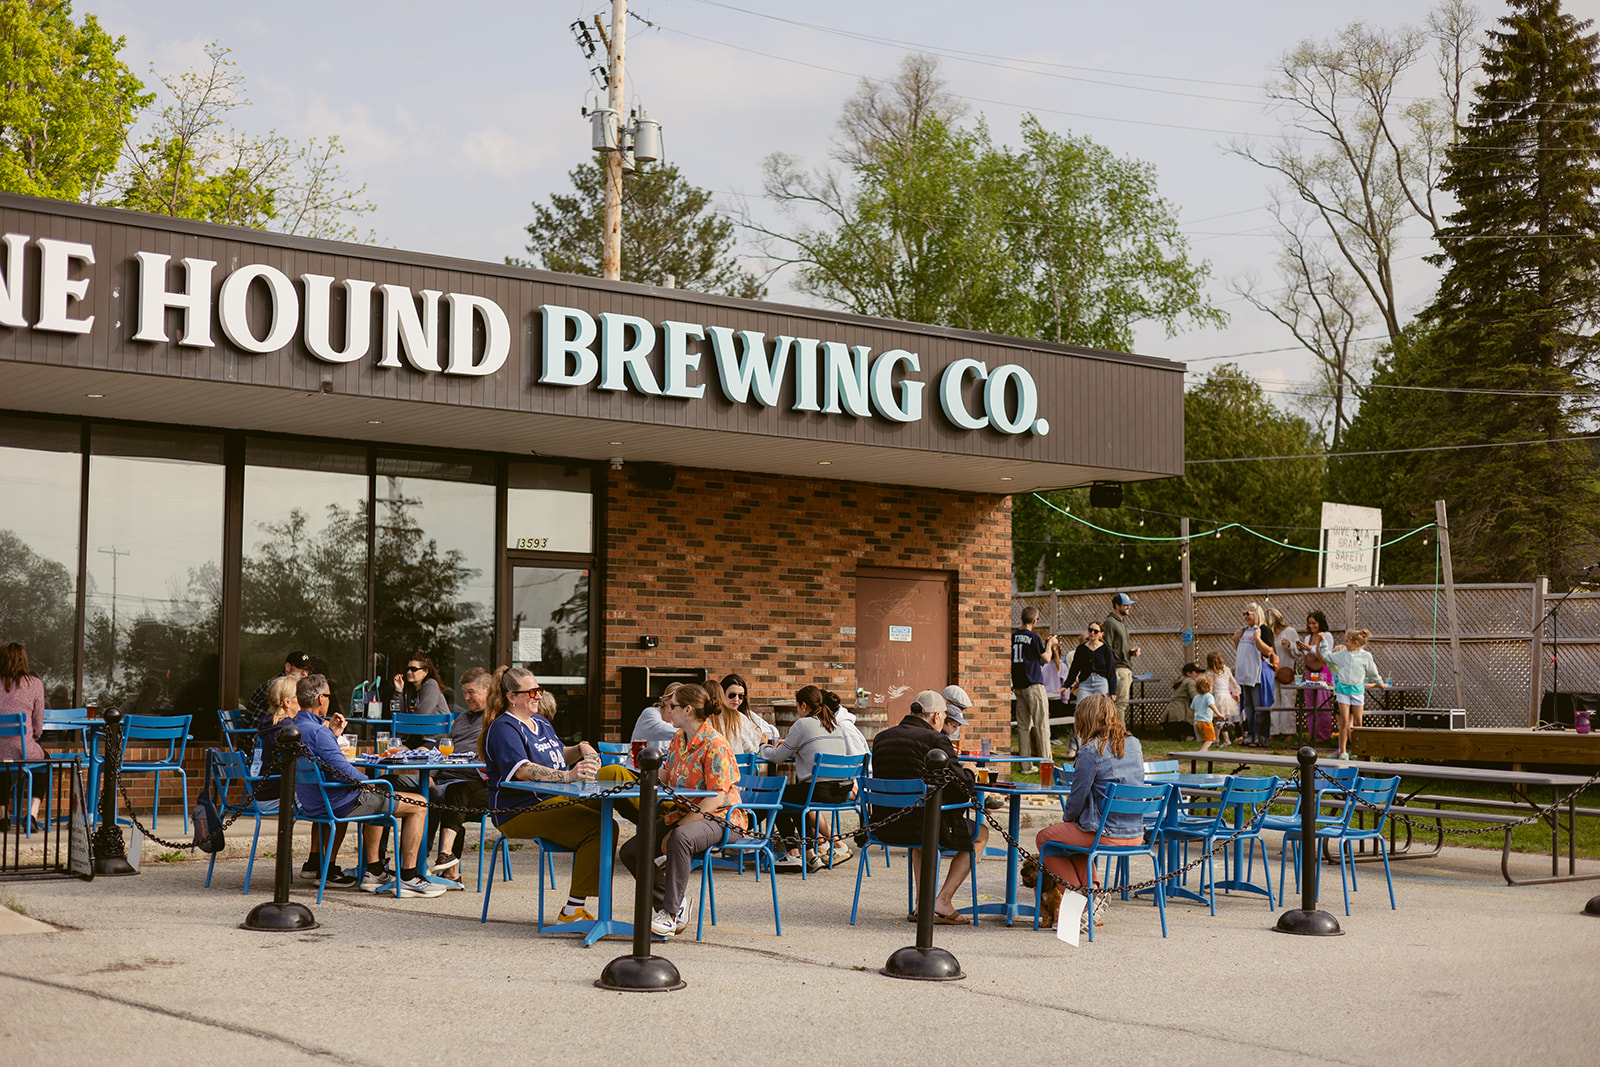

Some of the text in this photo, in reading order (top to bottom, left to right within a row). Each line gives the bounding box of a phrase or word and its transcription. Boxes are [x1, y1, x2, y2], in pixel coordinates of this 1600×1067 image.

[132, 250, 511, 377] HOUND
[538, 304, 926, 423] BREWING
[940, 358, 1049, 436] CO.
[519, 538, 547, 548] 3593
[1335, 549, 1364, 562] SAFETY
[1013, 643, 1024, 663] 11
[549, 748, 566, 770] 94
